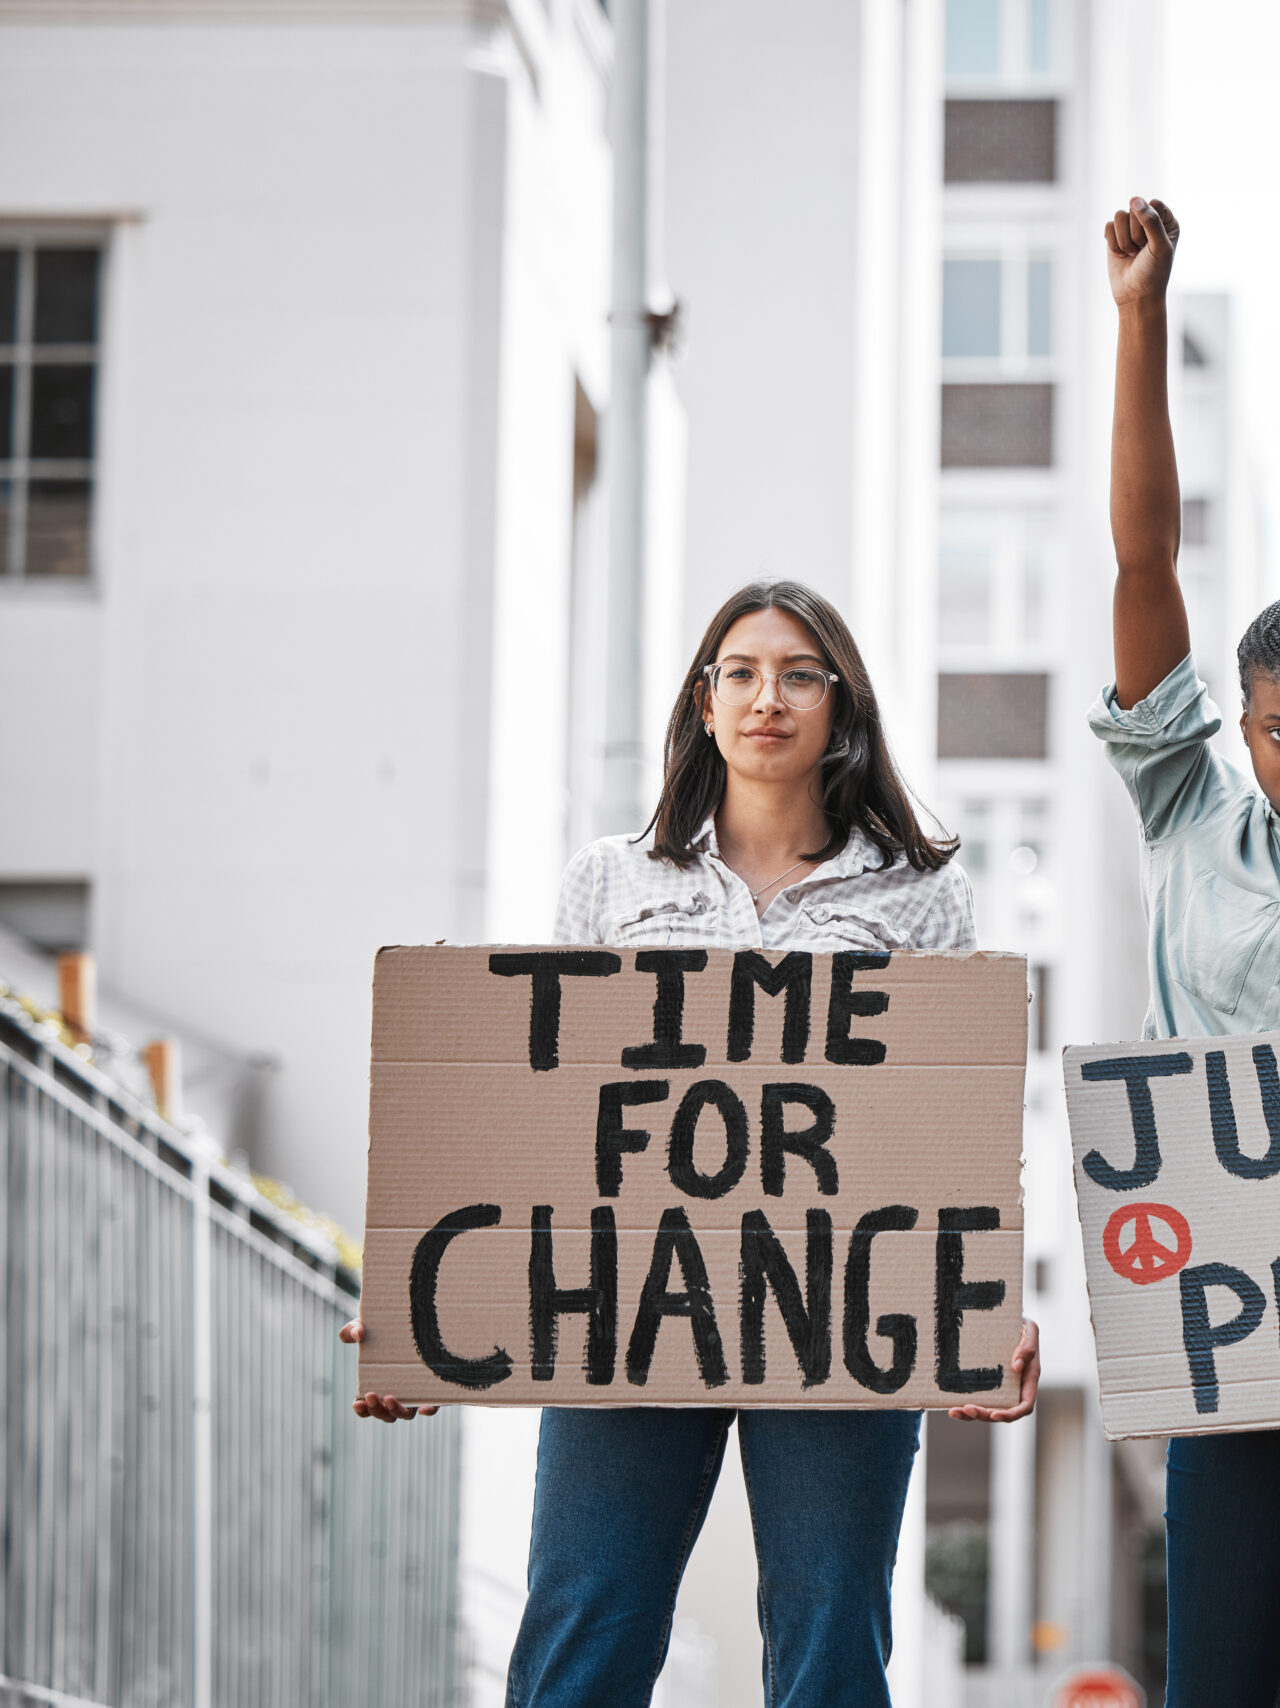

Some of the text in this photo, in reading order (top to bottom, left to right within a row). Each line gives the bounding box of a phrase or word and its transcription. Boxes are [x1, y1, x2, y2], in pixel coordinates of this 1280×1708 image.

[489, 949, 892, 1072] TIME
[594, 1078, 840, 1200] FOR
[408, 1203, 1006, 1395] CHANGE
